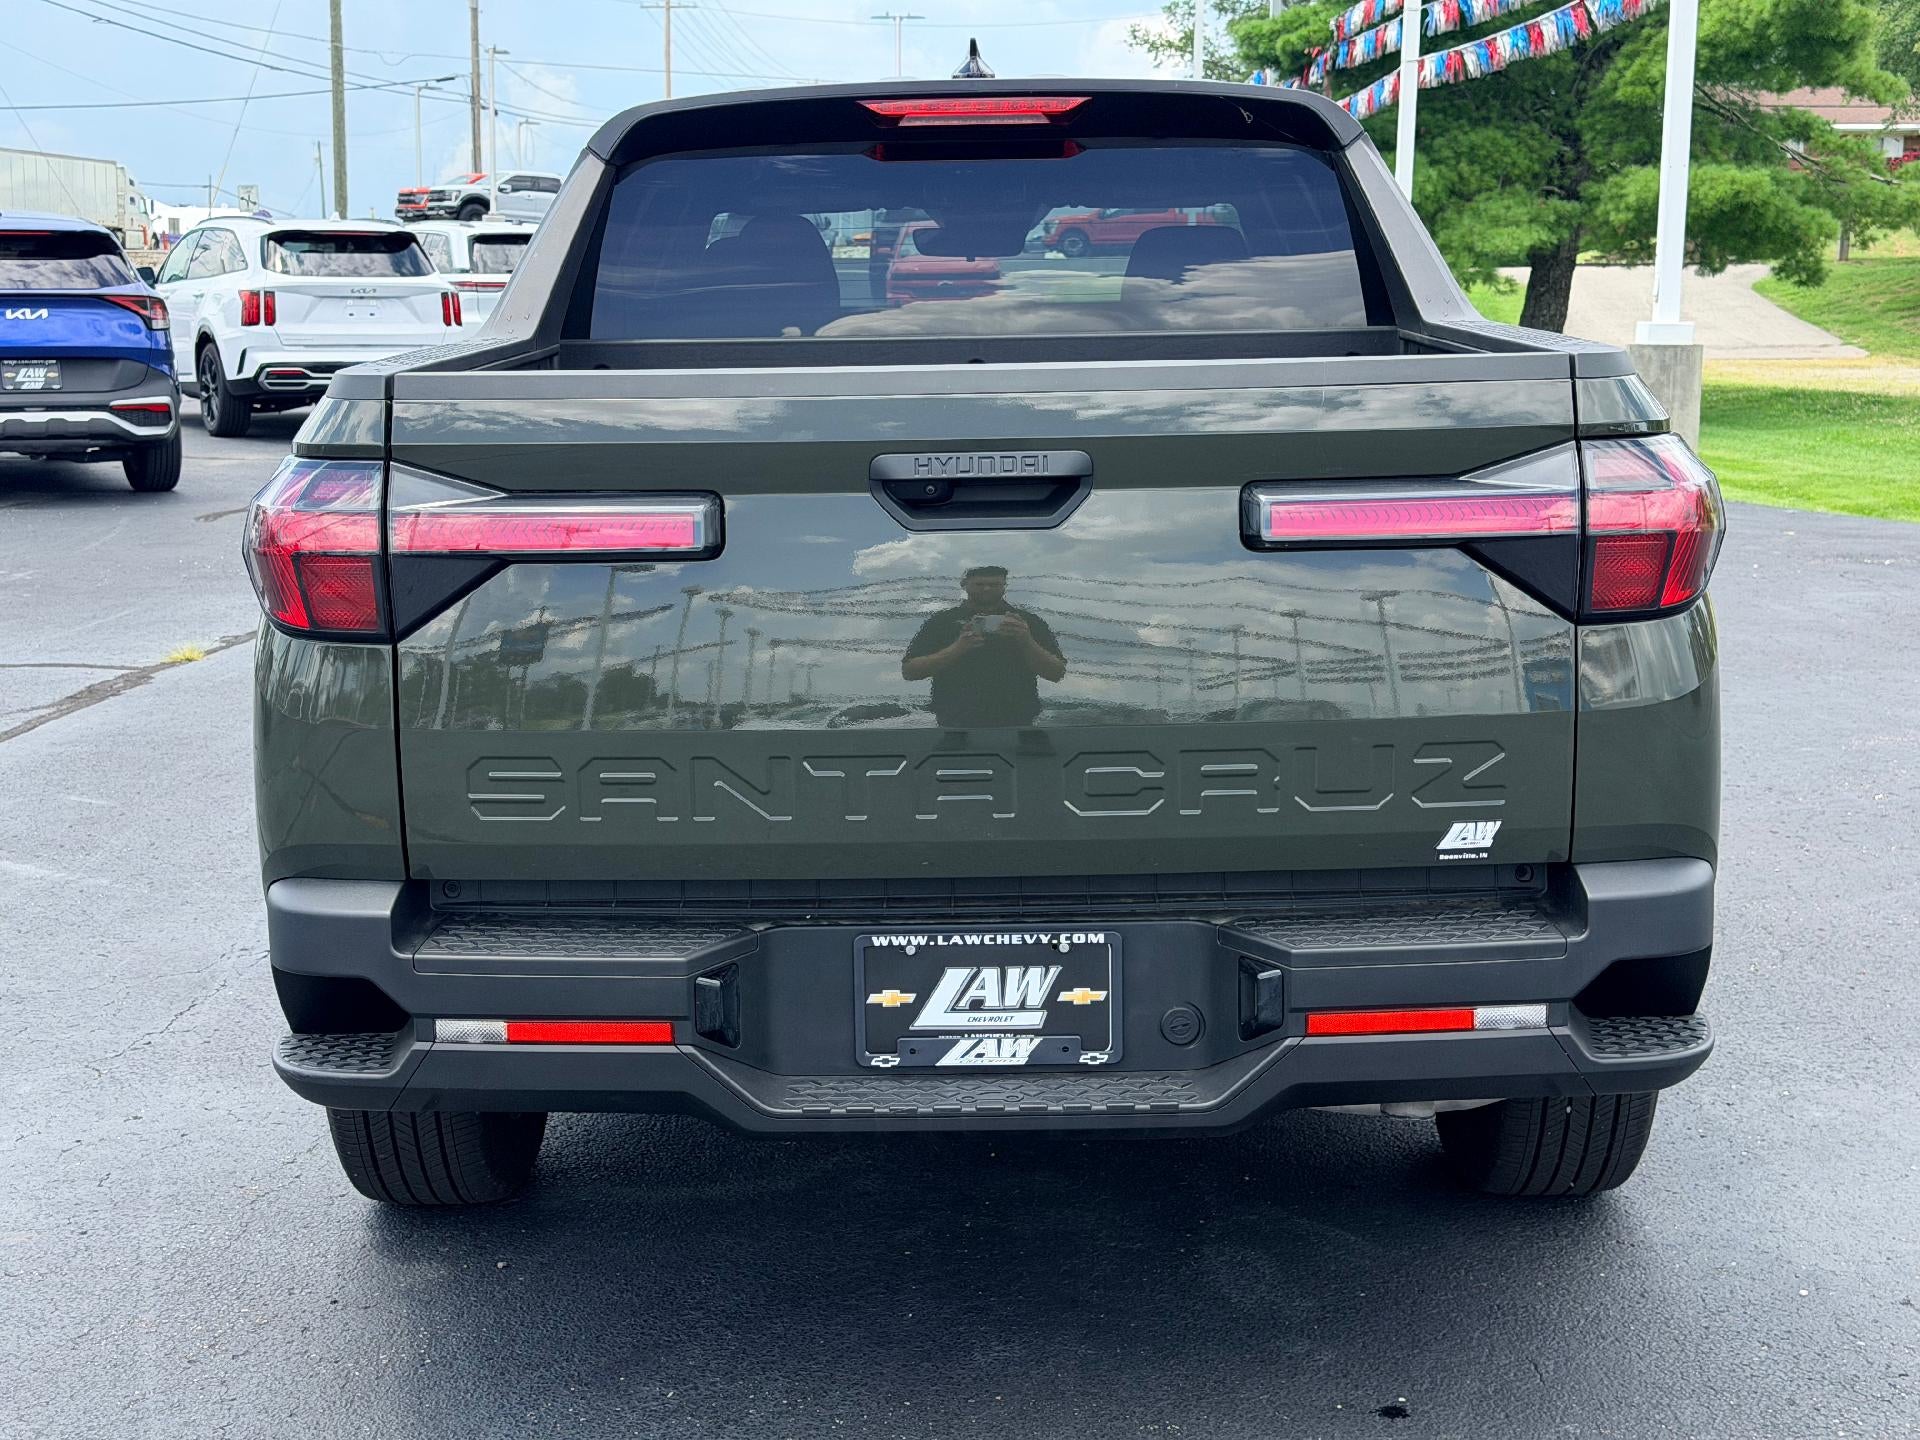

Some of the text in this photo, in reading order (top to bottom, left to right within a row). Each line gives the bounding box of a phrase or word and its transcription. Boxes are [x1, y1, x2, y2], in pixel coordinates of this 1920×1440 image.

[5, 308, 48, 320] KIA
[15, 367, 47, 382] LAW
[913, 454, 1050, 477] HYUNDAI
[466, 740, 1507, 822] SANTA CRUZ
[1435, 820, 1502, 850] LAW
[871, 933, 1106, 947] WWW.LAWCHEVY.COM
[909, 965, 1063, 1031] LAW
[967, 1015, 1016, 1024] CHEVROLET
[935, 1037, 1043, 1067] LAW
